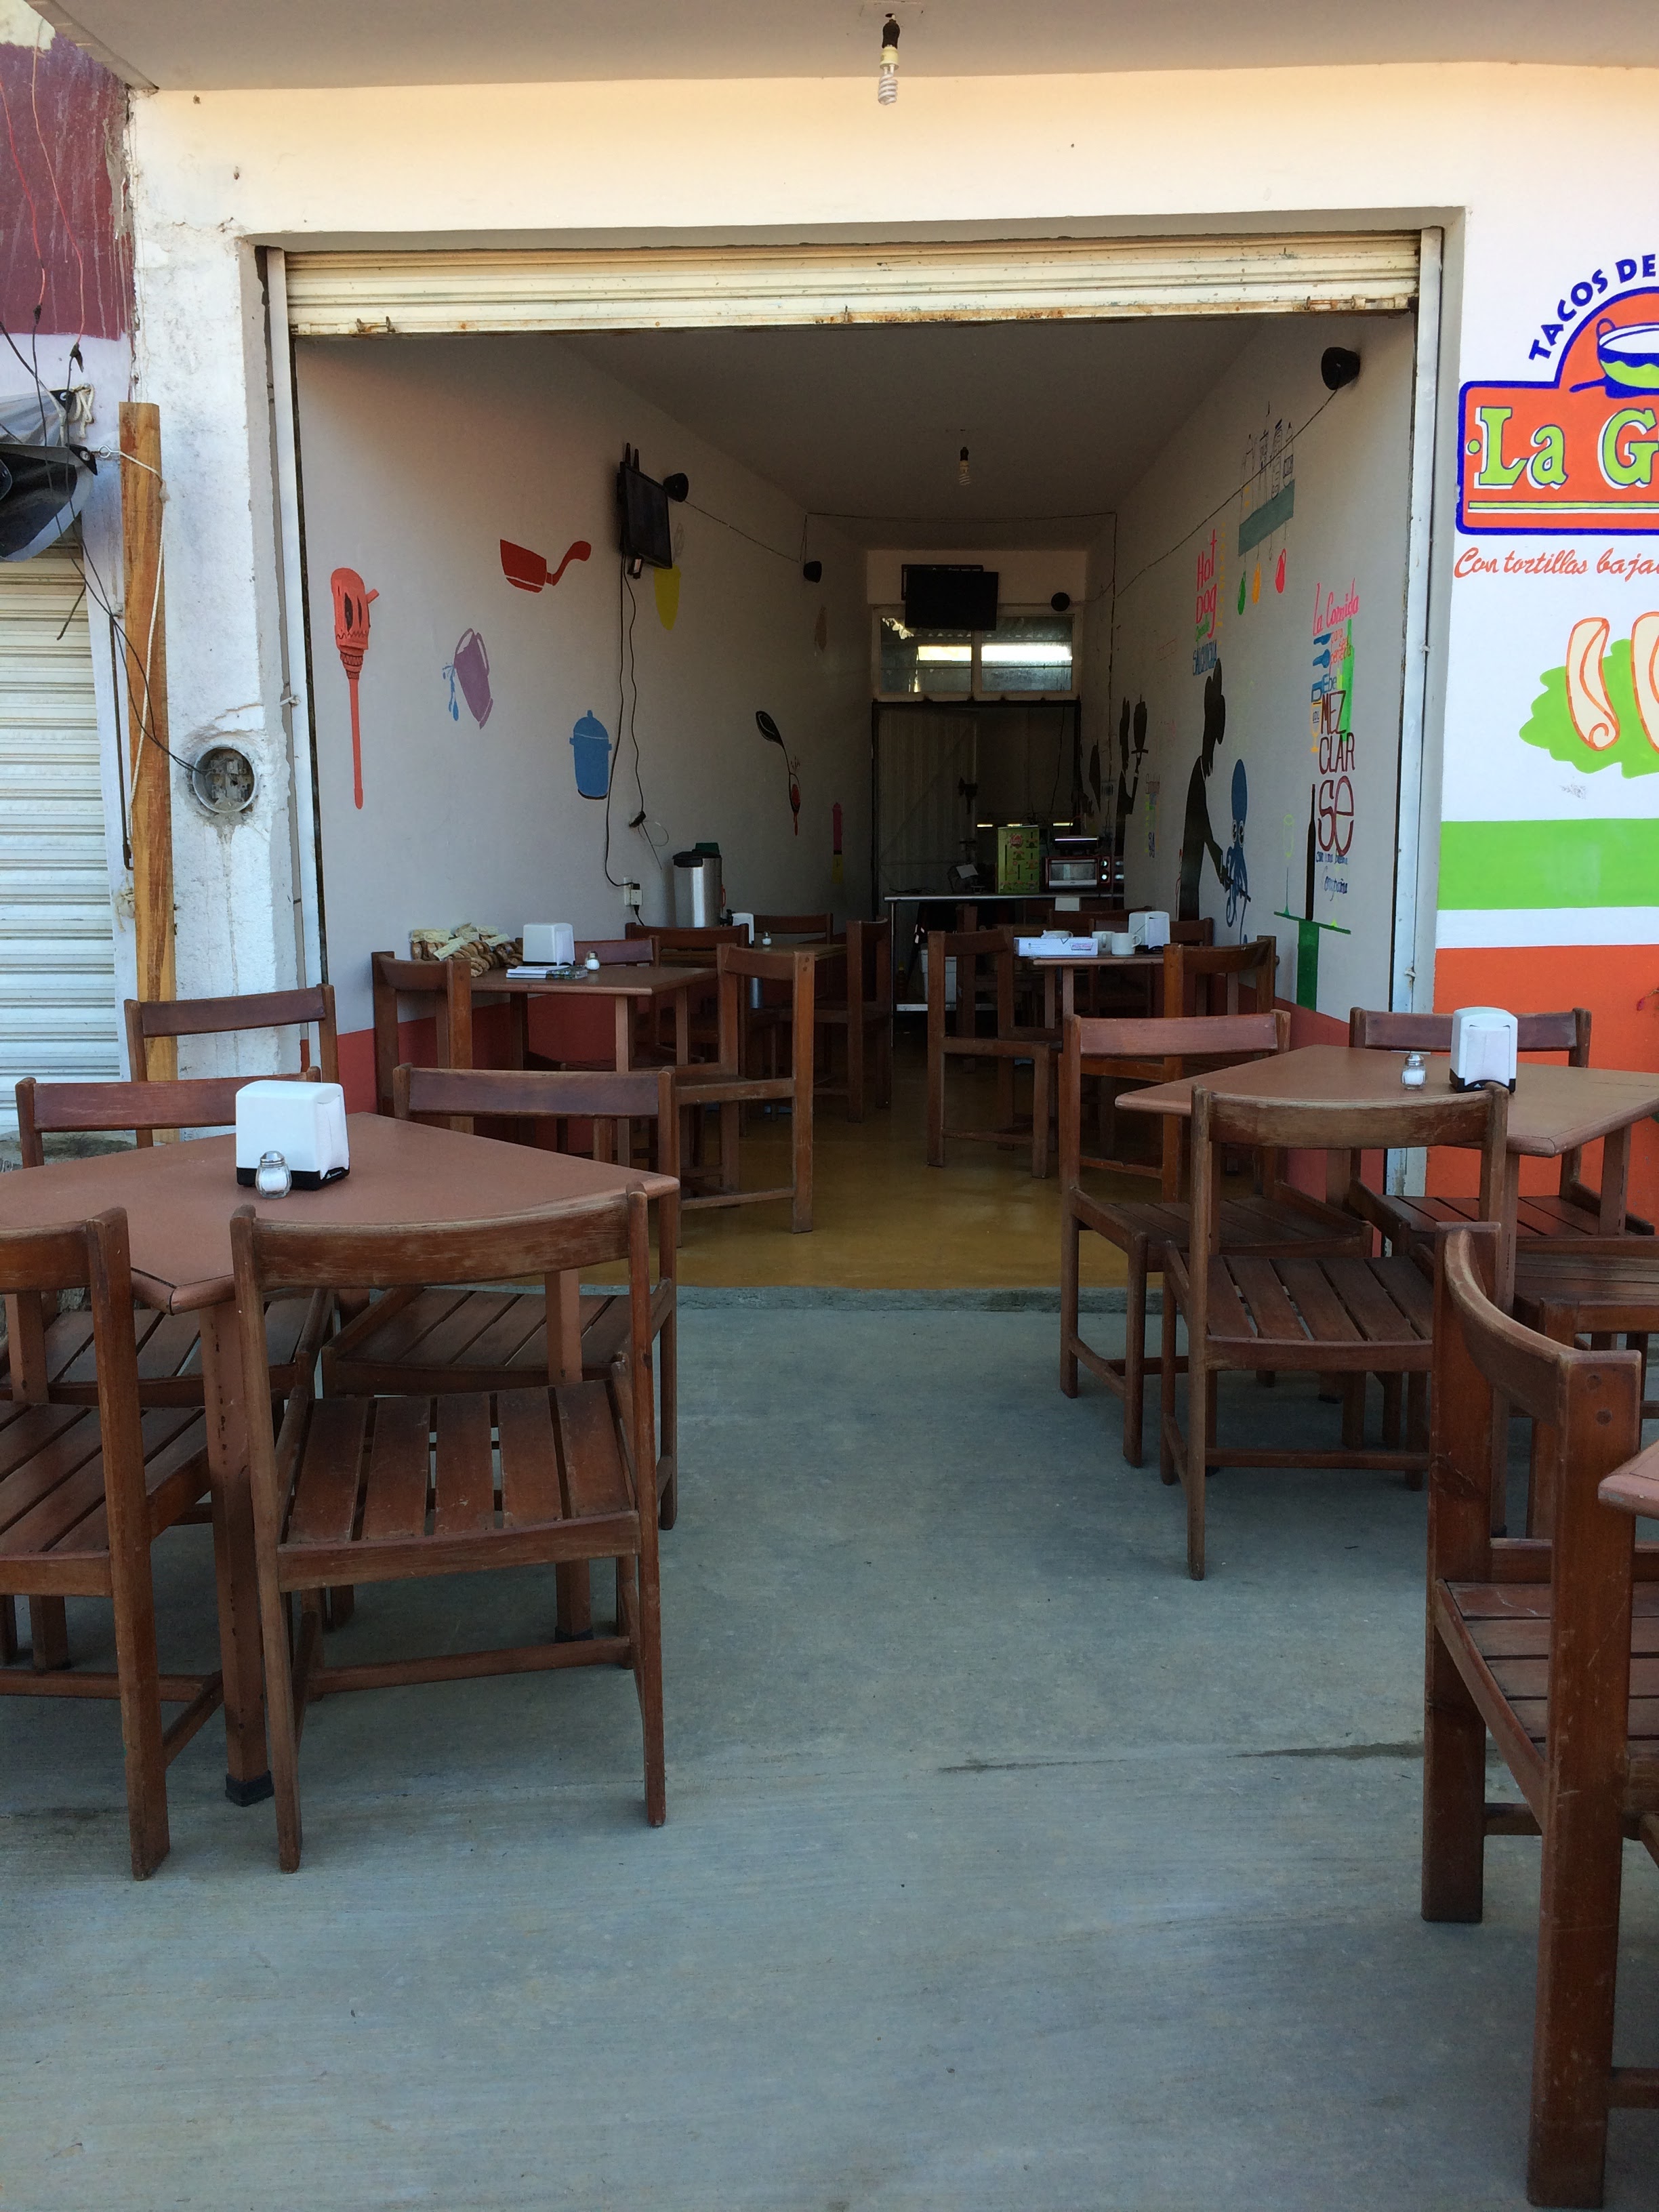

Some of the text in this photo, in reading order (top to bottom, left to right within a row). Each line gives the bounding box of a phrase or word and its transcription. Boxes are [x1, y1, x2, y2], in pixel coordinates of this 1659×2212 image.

[1528, 253, 1656, 361] TACOS DE
[1474, 407, 1569, 489] La
[1197, 529, 1218, 592] Hot
[1454, 546, 1659, 582] Con tortillas baja
[1195, 583, 1217, 639] Dog
[1313, 577, 1359, 637] La Comida
